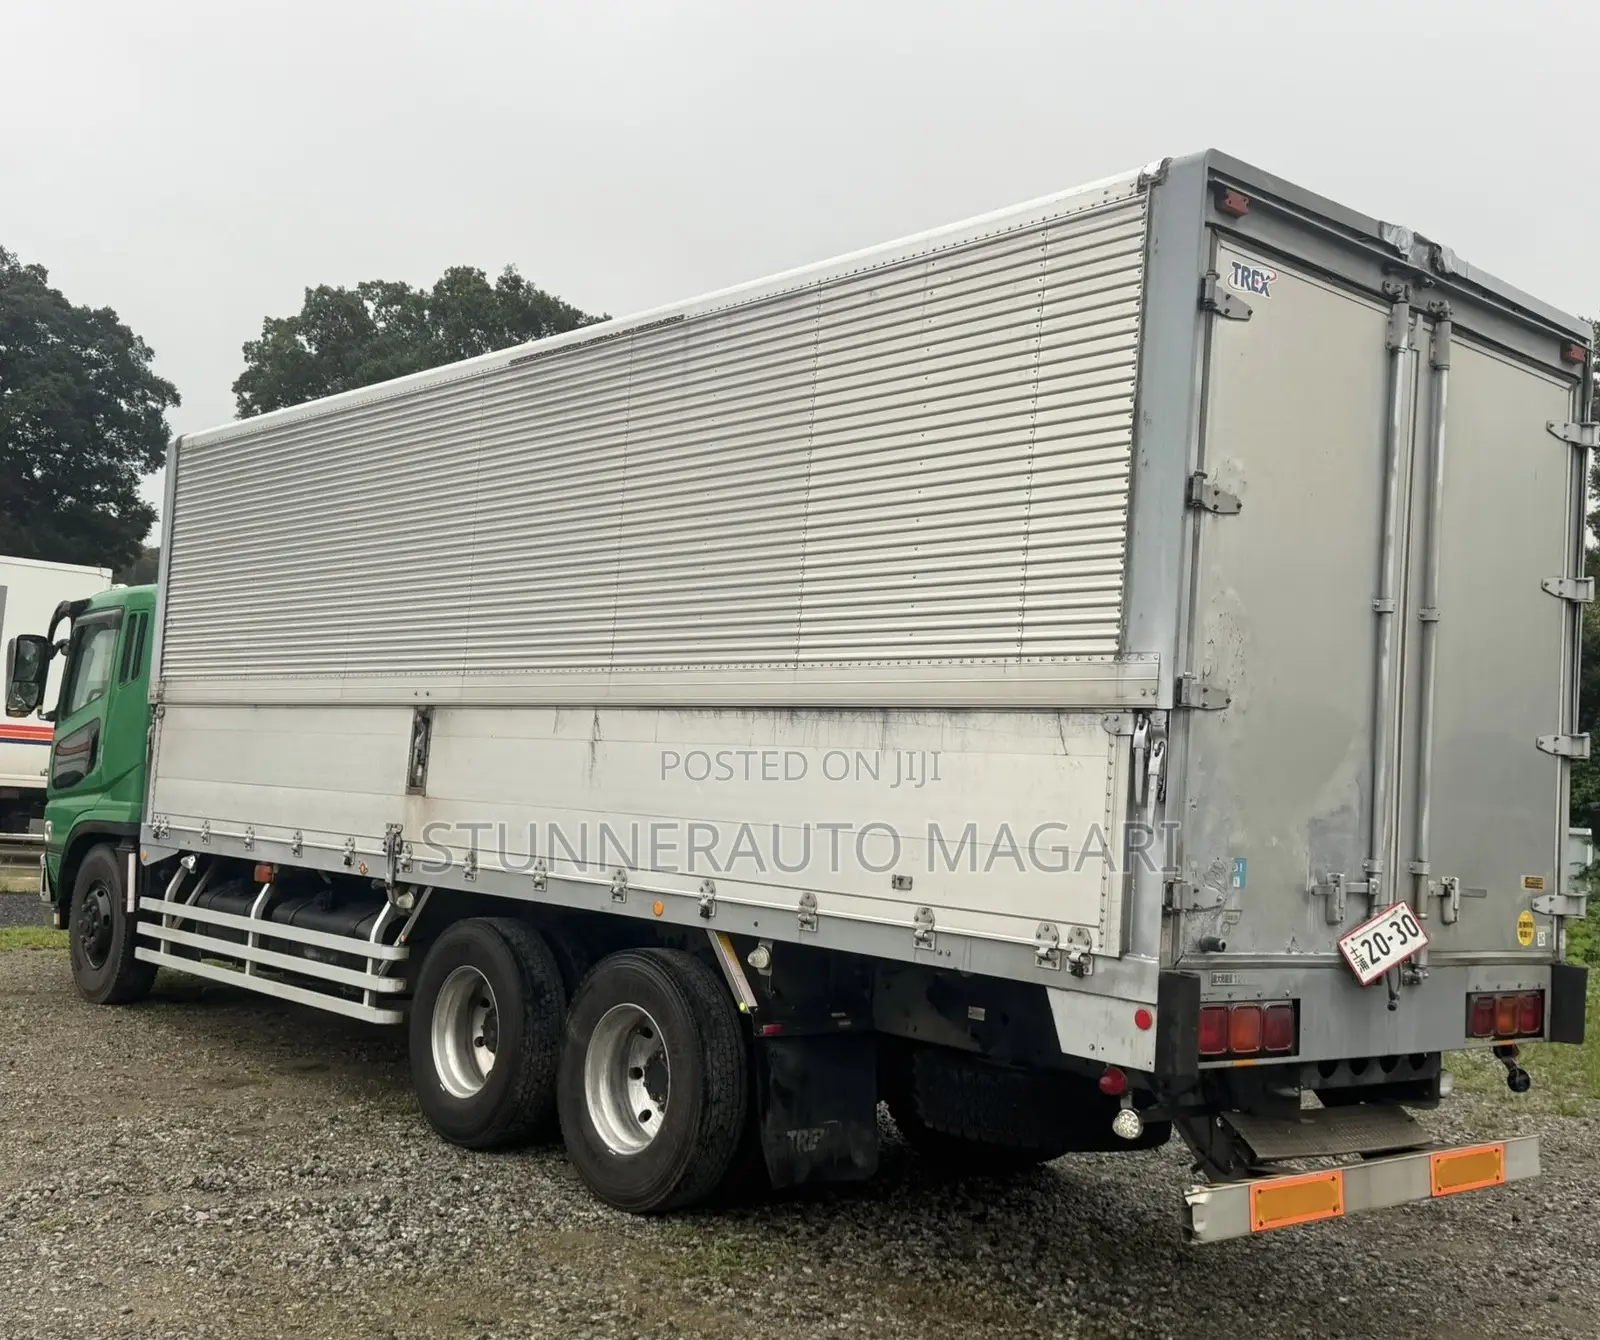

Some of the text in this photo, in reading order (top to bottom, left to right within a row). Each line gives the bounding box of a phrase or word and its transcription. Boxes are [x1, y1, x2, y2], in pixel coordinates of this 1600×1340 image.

[1231, 261, 1271, 298] TREX
[1360, 913, 1420, 966] 20-30
[787, 1127, 830, 1153] TRE
